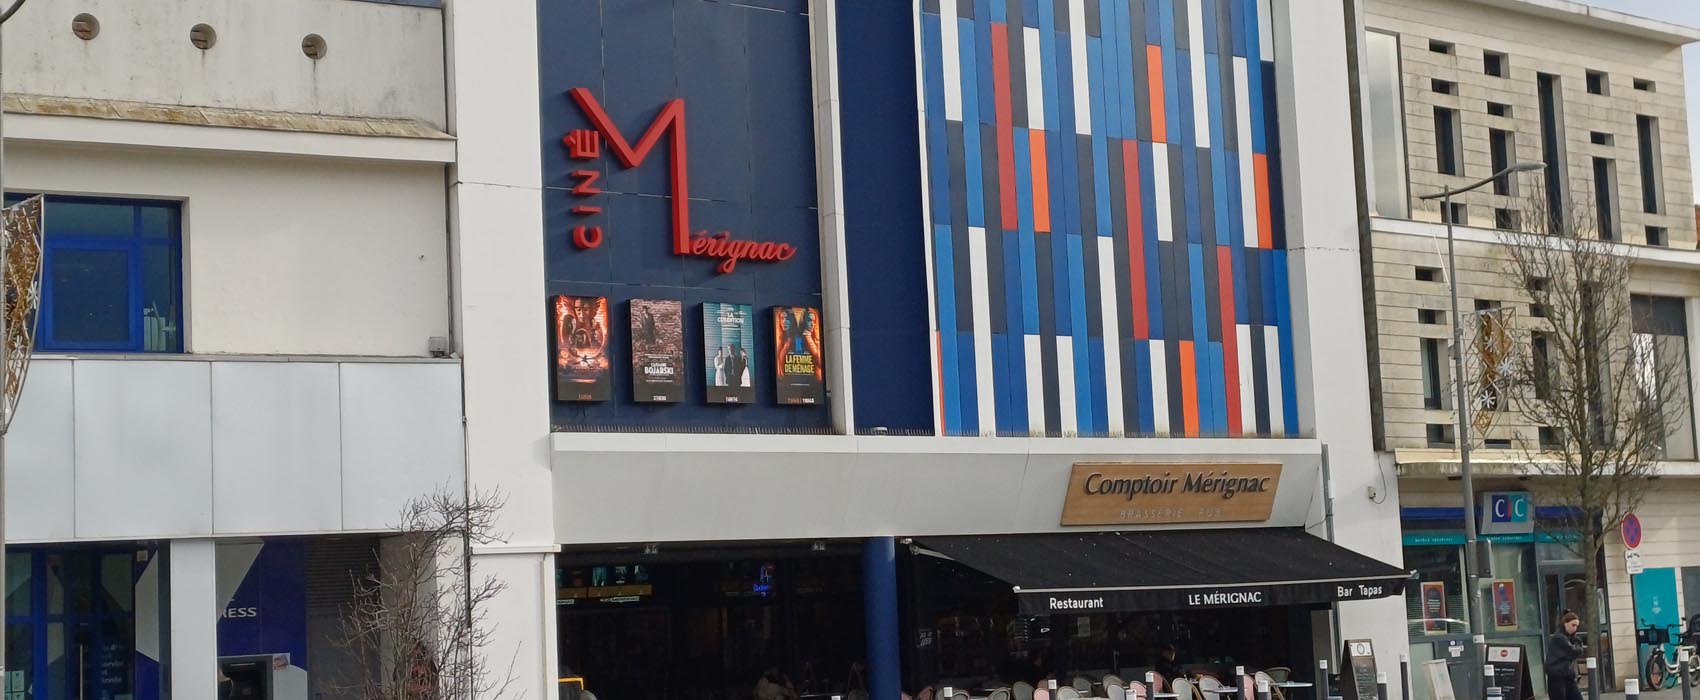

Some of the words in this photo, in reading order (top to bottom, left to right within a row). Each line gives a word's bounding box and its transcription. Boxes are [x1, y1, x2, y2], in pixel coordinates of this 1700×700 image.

[563, 129, 602, 249] CINÉ
[1085, 472, 1178, 500] Comptoir
[1182, 471, 1271, 499] Mérignac
[1495, 499, 1525, 518] CIC
[1188, 594, 1201, 605] LE
[1203, 590, 1262, 605] MÉRIGNAC
[1337, 586, 1353, 597] Bar
[1358, 584, 1383, 598] Tapas
[1049, 597, 1104, 610] Restaurant
